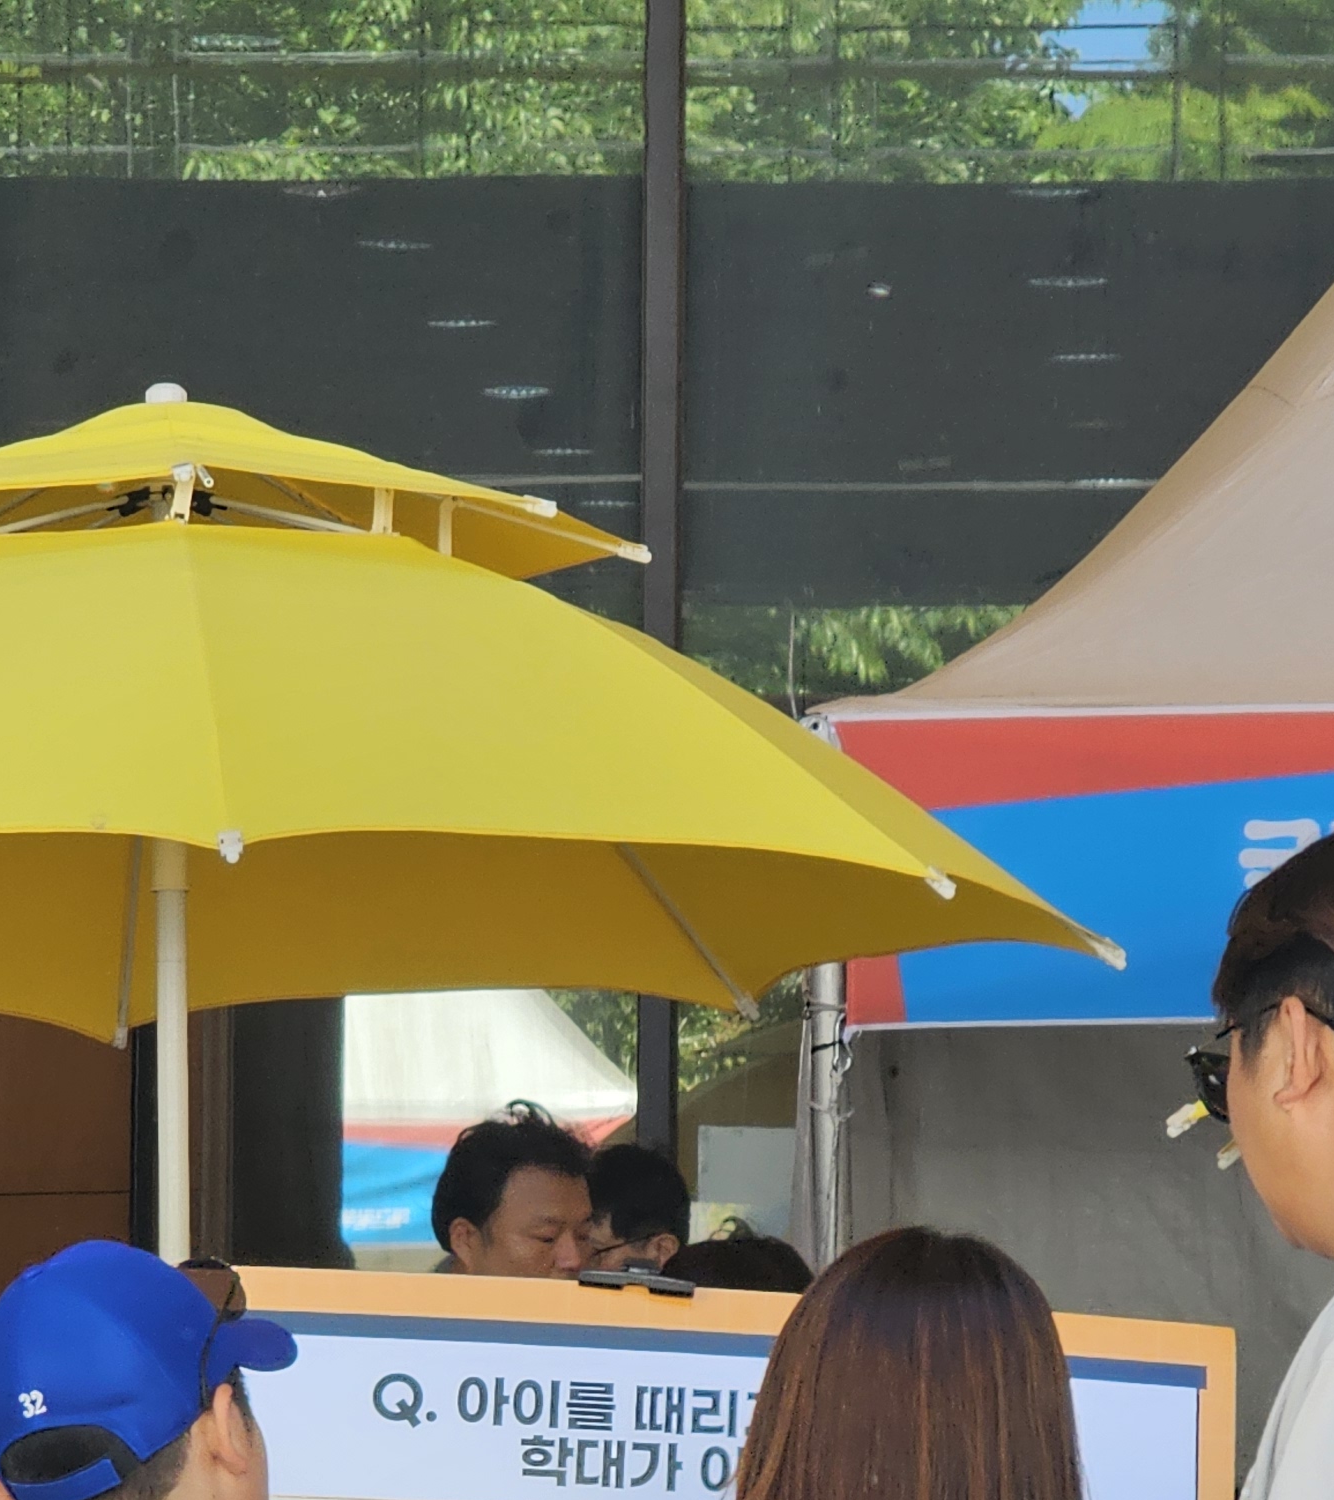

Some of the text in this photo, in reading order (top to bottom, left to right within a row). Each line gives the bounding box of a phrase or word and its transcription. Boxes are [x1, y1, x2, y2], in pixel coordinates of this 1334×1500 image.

[18, 1389, 48, 1419] 32
[372, 1373, 757, 1439] Q. 아이를 때리
[520, 1434, 684, 1492] 학대가
